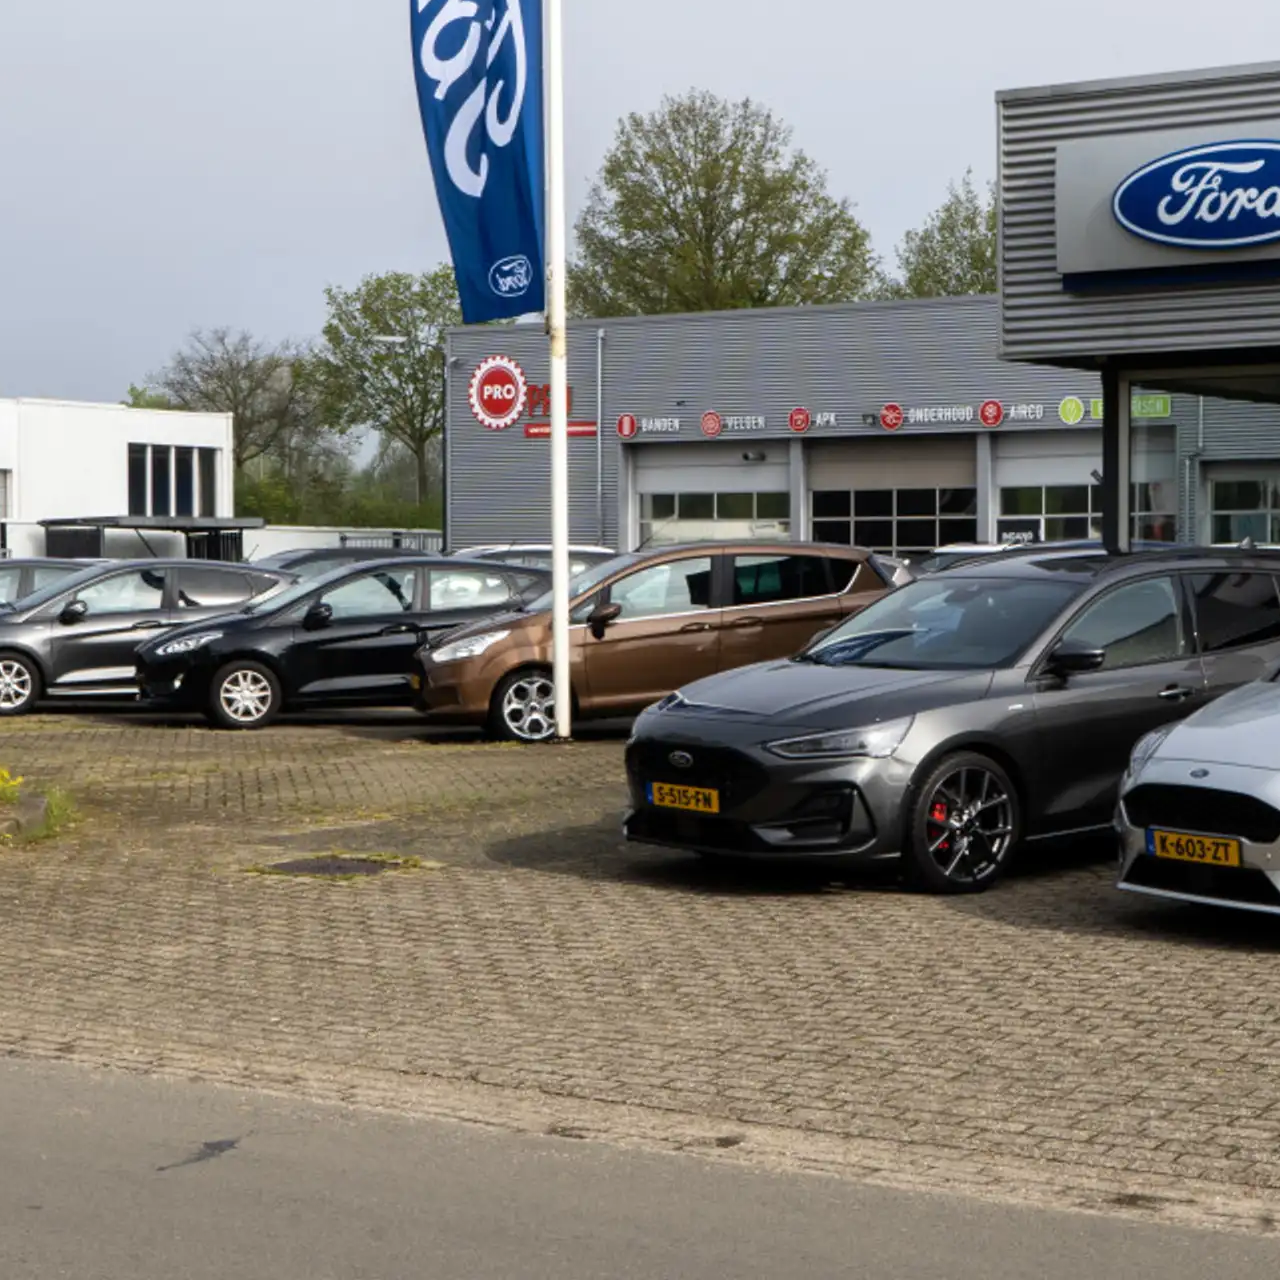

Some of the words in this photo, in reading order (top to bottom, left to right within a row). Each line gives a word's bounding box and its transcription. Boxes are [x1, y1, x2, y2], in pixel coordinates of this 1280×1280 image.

[483, 383, 516, 400] PRO
[527, 383, 573, 417] PR
[907, 405, 974, 424] ONDERHOUD
[1008, 403, 1044, 421] AIRCO
[641, 417, 681, 432] BANDEN
[656, 785, 713, 809] S-515-FN
[1159, 834, 1232, 862] K-603-ZT
